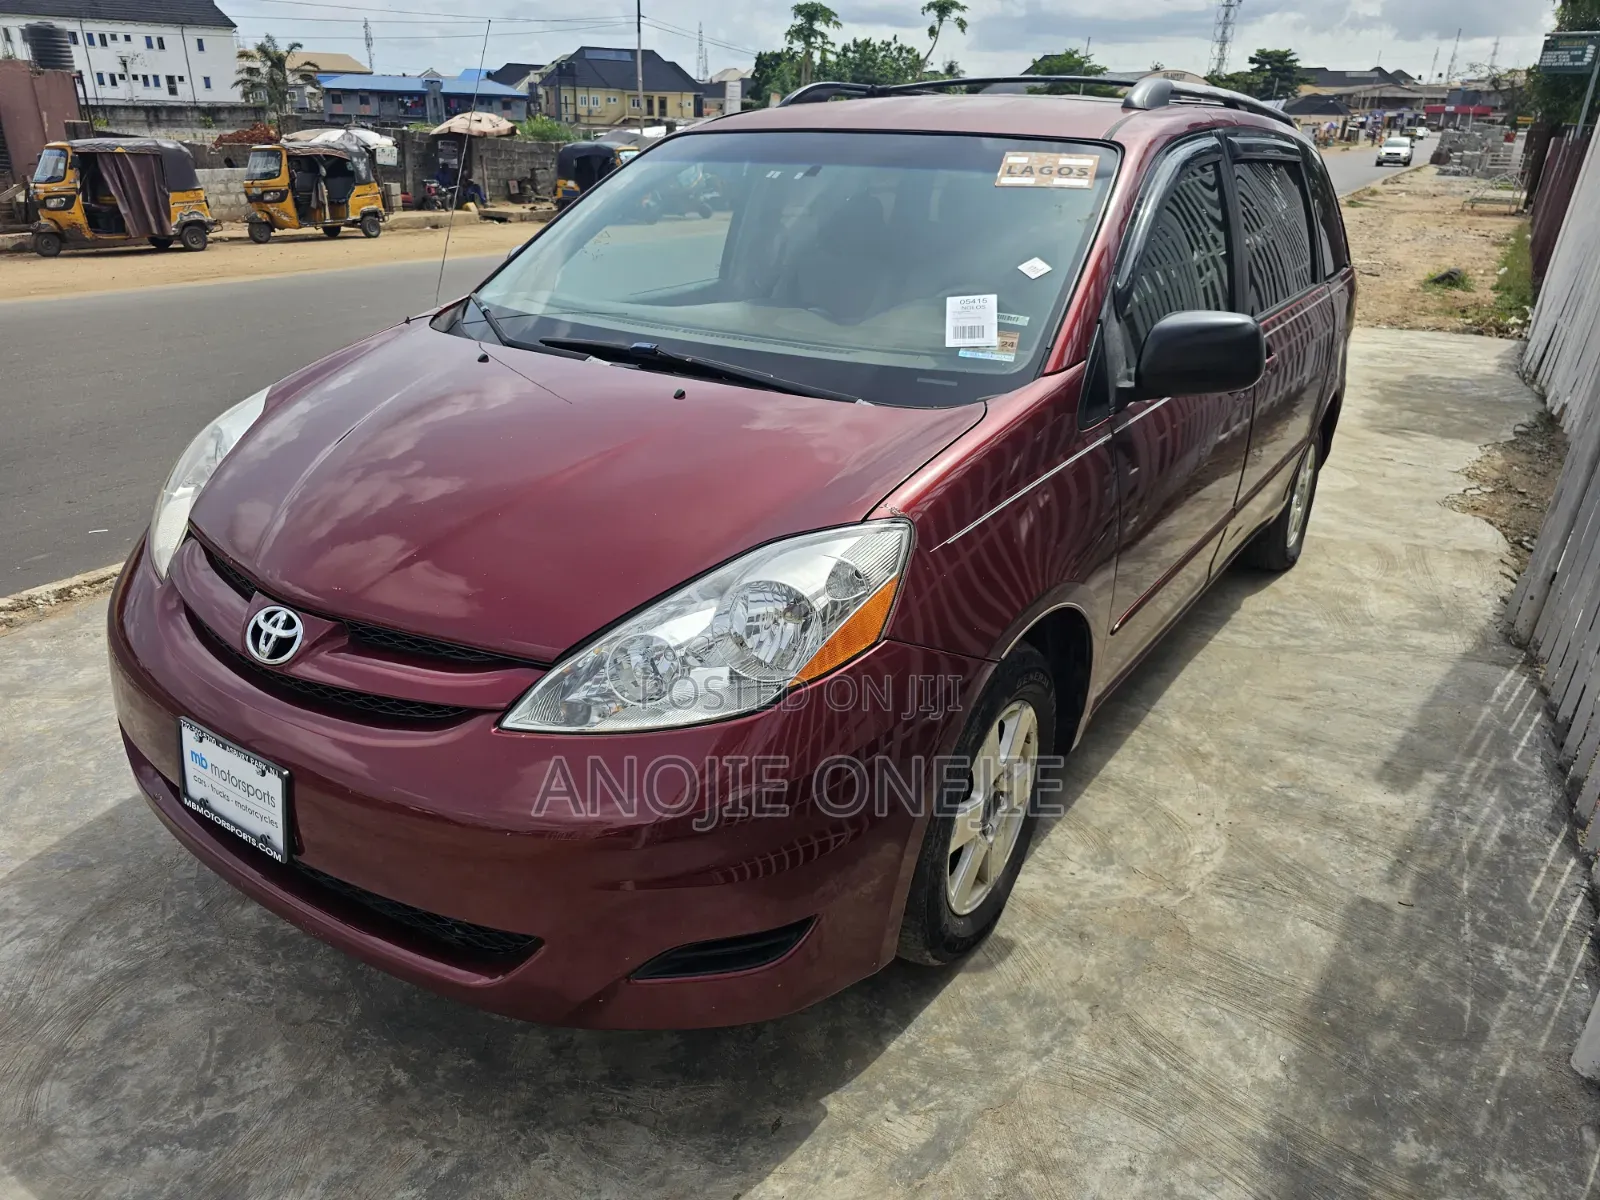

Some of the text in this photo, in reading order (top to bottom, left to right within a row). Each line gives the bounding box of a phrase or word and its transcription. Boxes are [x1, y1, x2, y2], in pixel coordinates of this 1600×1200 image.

[1006, 165, 1089, 177] LAGOS
[1001, 340, 1015, 348] 24
[190, 750, 276, 808] mb motorsports
[193, 774, 279, 829] cars trucks motorcycles
[184, 797, 282, 862] MBMOTORSPORTS.COM
